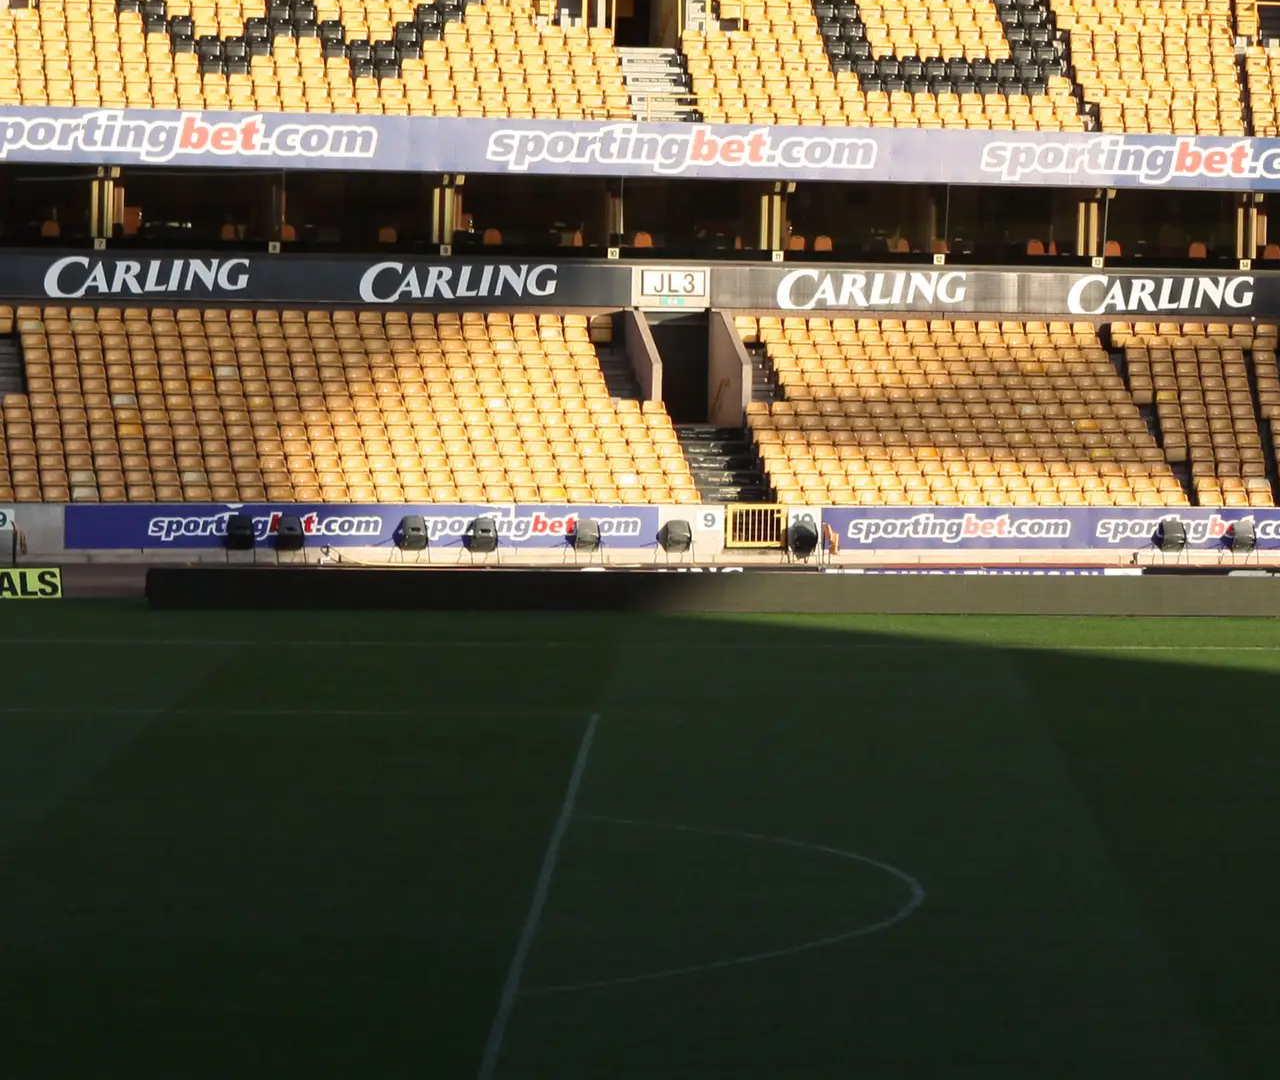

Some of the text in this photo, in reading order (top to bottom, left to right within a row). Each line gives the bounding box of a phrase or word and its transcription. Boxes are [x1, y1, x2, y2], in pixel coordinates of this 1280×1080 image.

[487, 125, 877, 173] sportingbet.com
[44, 256, 250, 298] CARLING
[359, 262, 558, 303] CARLING
[653, 272, 695, 294] JL3
[776, 269, 967, 310] CARLING
[1067, 274, 1254, 314] CARLING
[703, 512, 716, 528] 9
[847, 513, 1071, 544] sportingbet.com
